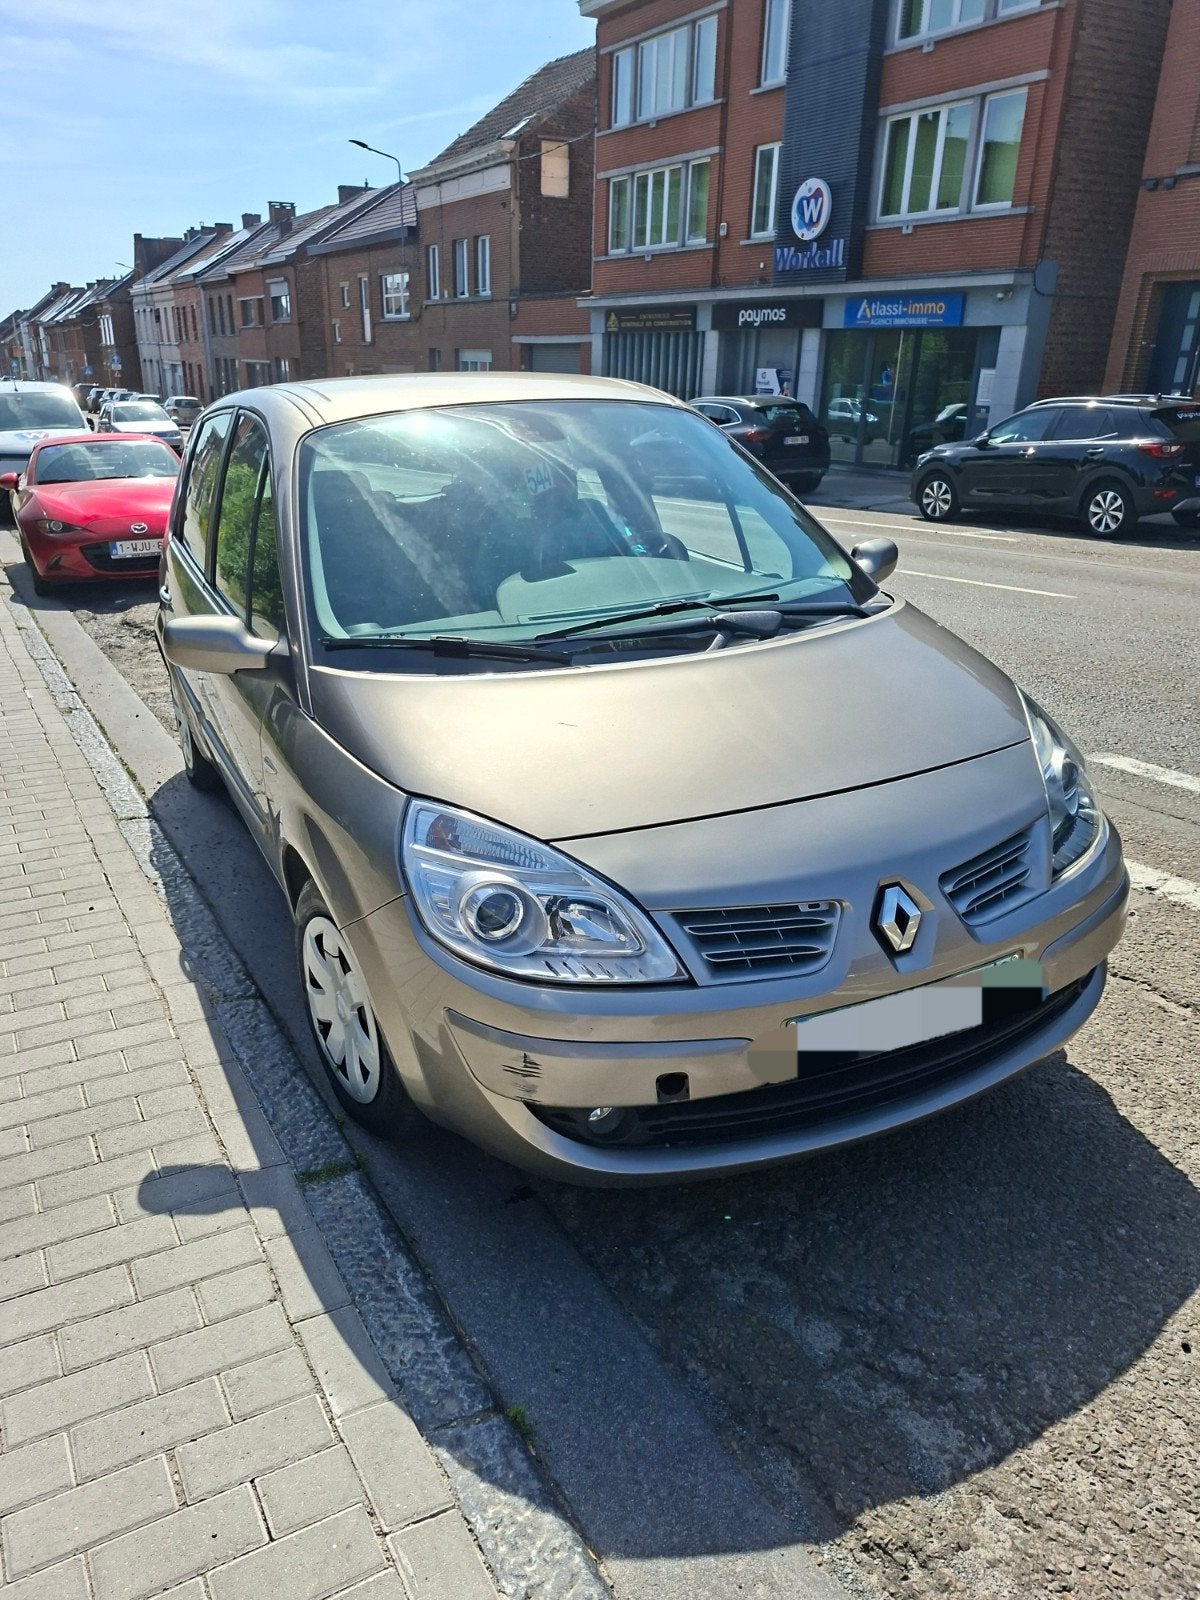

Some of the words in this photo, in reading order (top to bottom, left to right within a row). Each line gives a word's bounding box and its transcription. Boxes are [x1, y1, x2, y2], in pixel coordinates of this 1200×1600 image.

[803, 197, 822, 224] W
[775, 239, 844, 271] Workall
[738, 308, 786, 326] paymos
[857, 299, 945, 319] Atlassi-immo
[526, 464, 551, 493] 544
